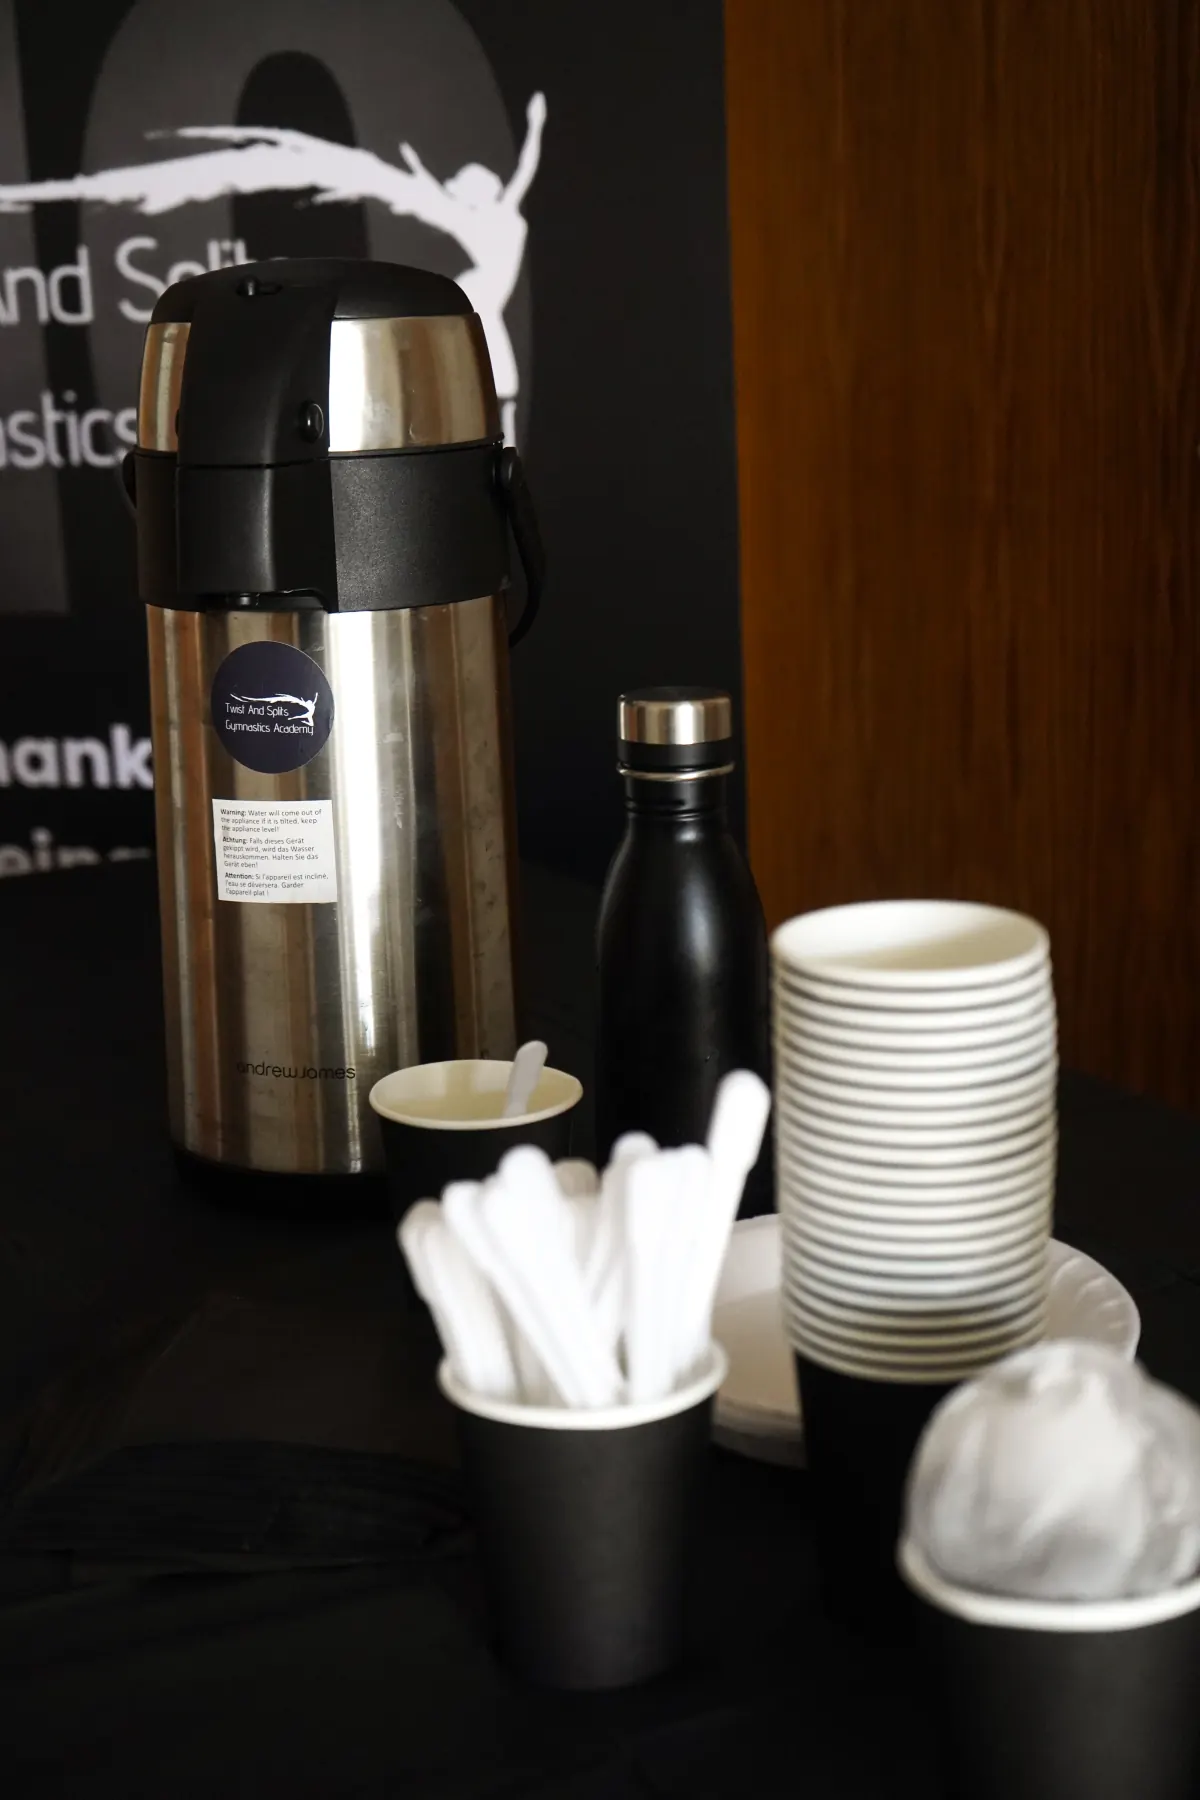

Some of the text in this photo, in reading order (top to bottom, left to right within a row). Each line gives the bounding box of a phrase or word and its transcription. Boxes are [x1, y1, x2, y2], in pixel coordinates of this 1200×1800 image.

[225, 702, 289, 718] Twist And Splits
[225, 720, 314, 736] Gymnastics Academy
[220, 809, 247, 817] Warning:
[223, 836, 248, 844] Achtung:
[245, 845, 260, 853] wird,
[277, 845, 289, 853] das
[224, 853, 270, 861] herauskommen.
[253, 889, 265, 897] plat
